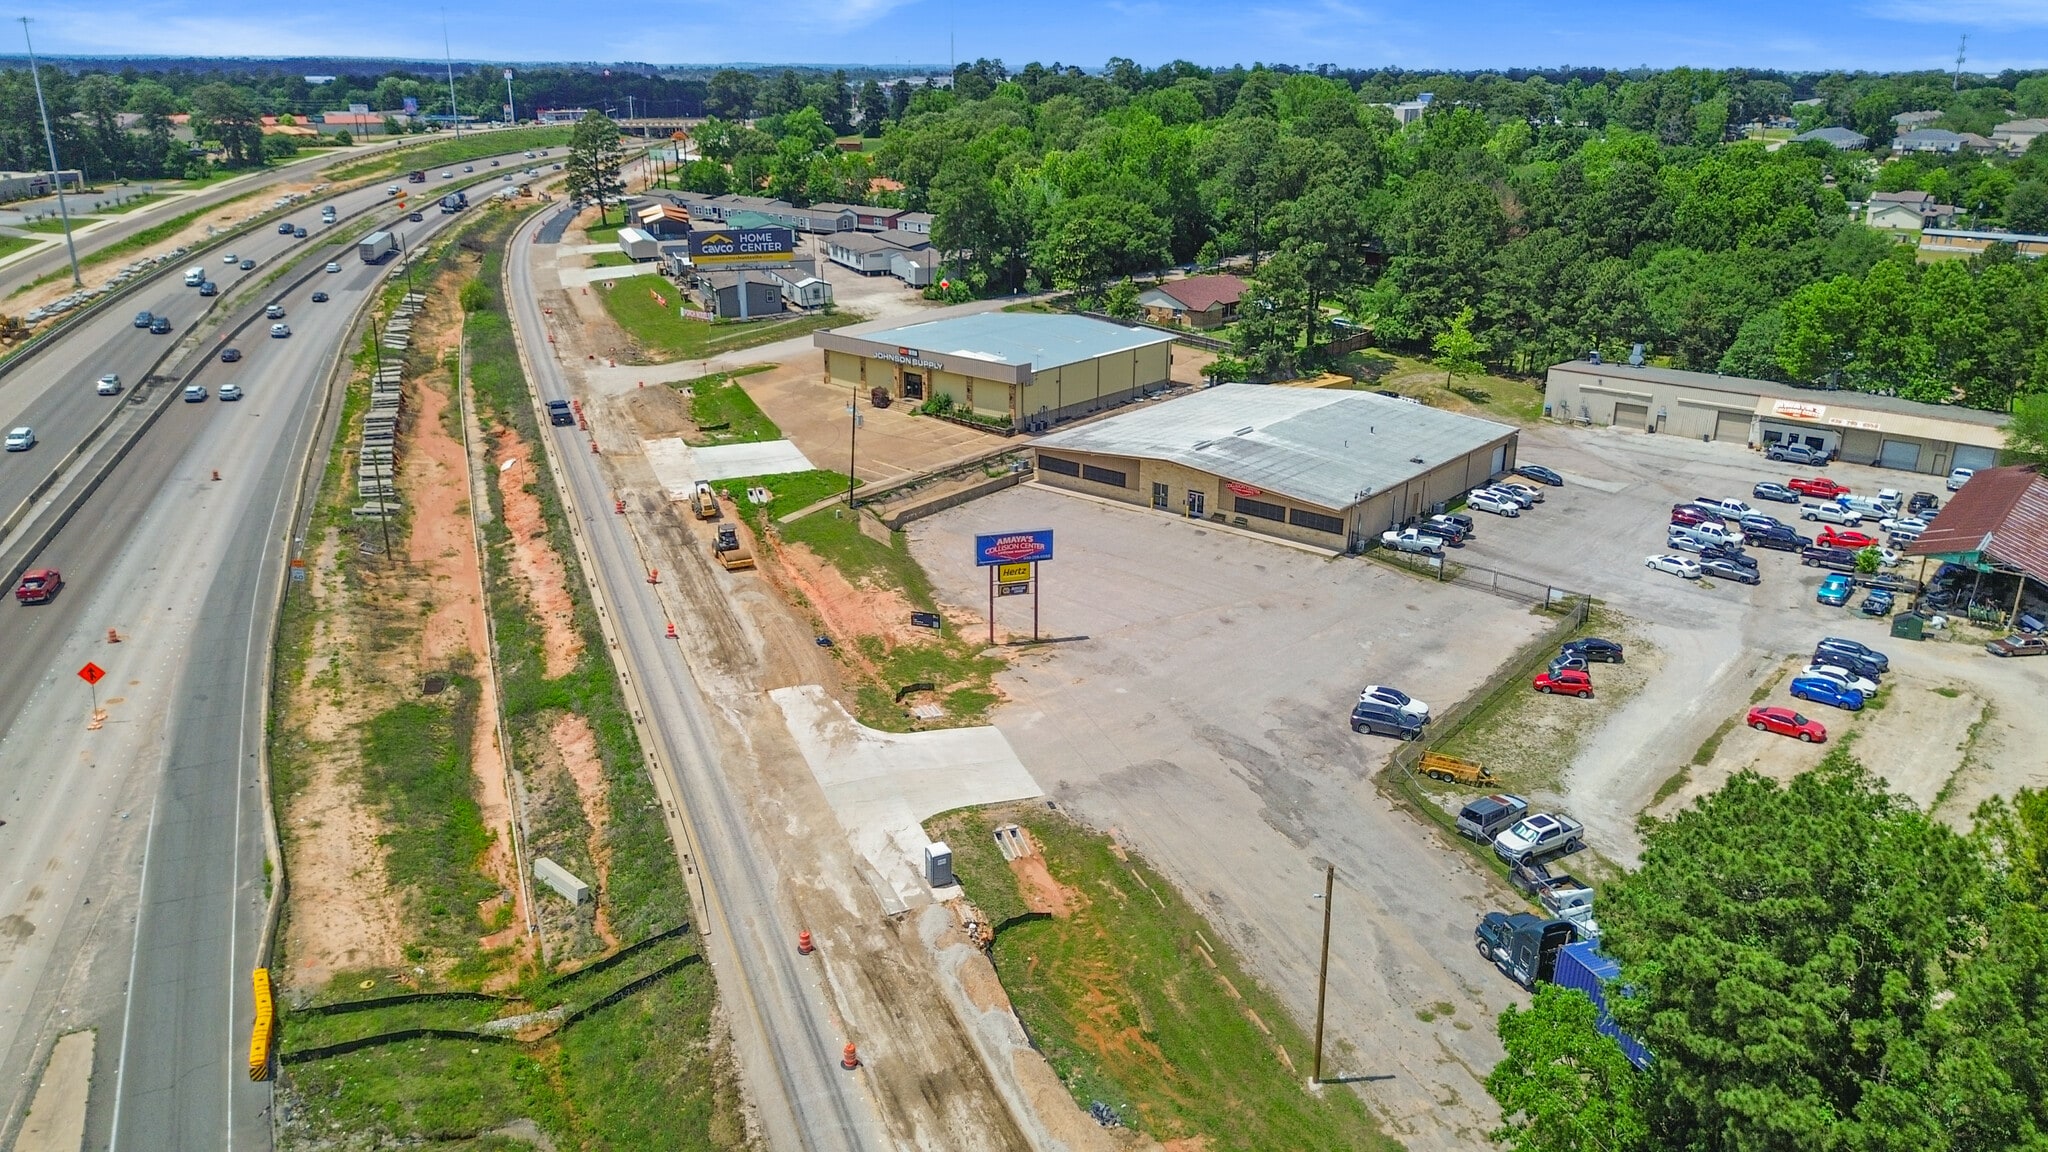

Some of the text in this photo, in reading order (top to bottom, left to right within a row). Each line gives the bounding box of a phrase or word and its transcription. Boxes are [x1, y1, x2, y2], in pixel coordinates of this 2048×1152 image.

[740, 233, 772, 243] HOME
[740, 243, 782, 252] CENTER
[873, 352, 911, 364] JOHNSON
[912, 359, 944, 370] SUPPLY
[997, 536, 1034, 545] AMAYA'S
[985, 542, 1045, 554] COLLISION CENTER
[1003, 567, 1026, 576] Hertz
